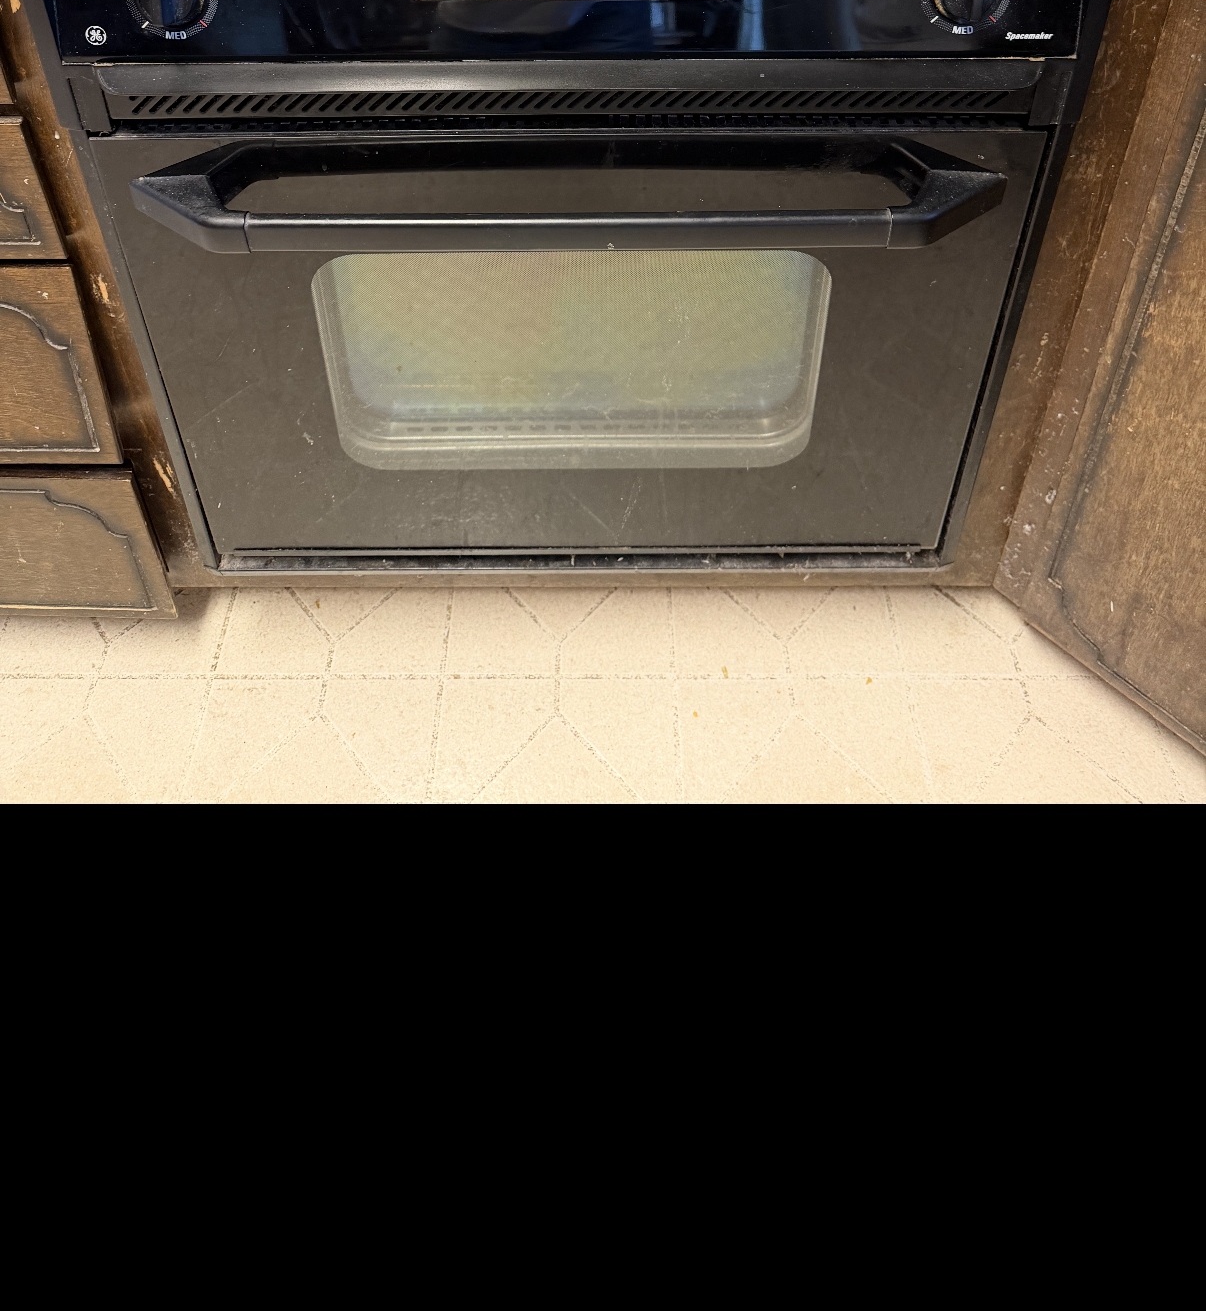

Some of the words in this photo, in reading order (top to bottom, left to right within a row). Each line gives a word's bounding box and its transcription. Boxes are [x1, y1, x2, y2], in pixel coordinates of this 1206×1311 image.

[165, 30, 187, 40] MED
[951, 25, 974, 35] MED
[1004, 31, 1054, 41] Spacemaker
